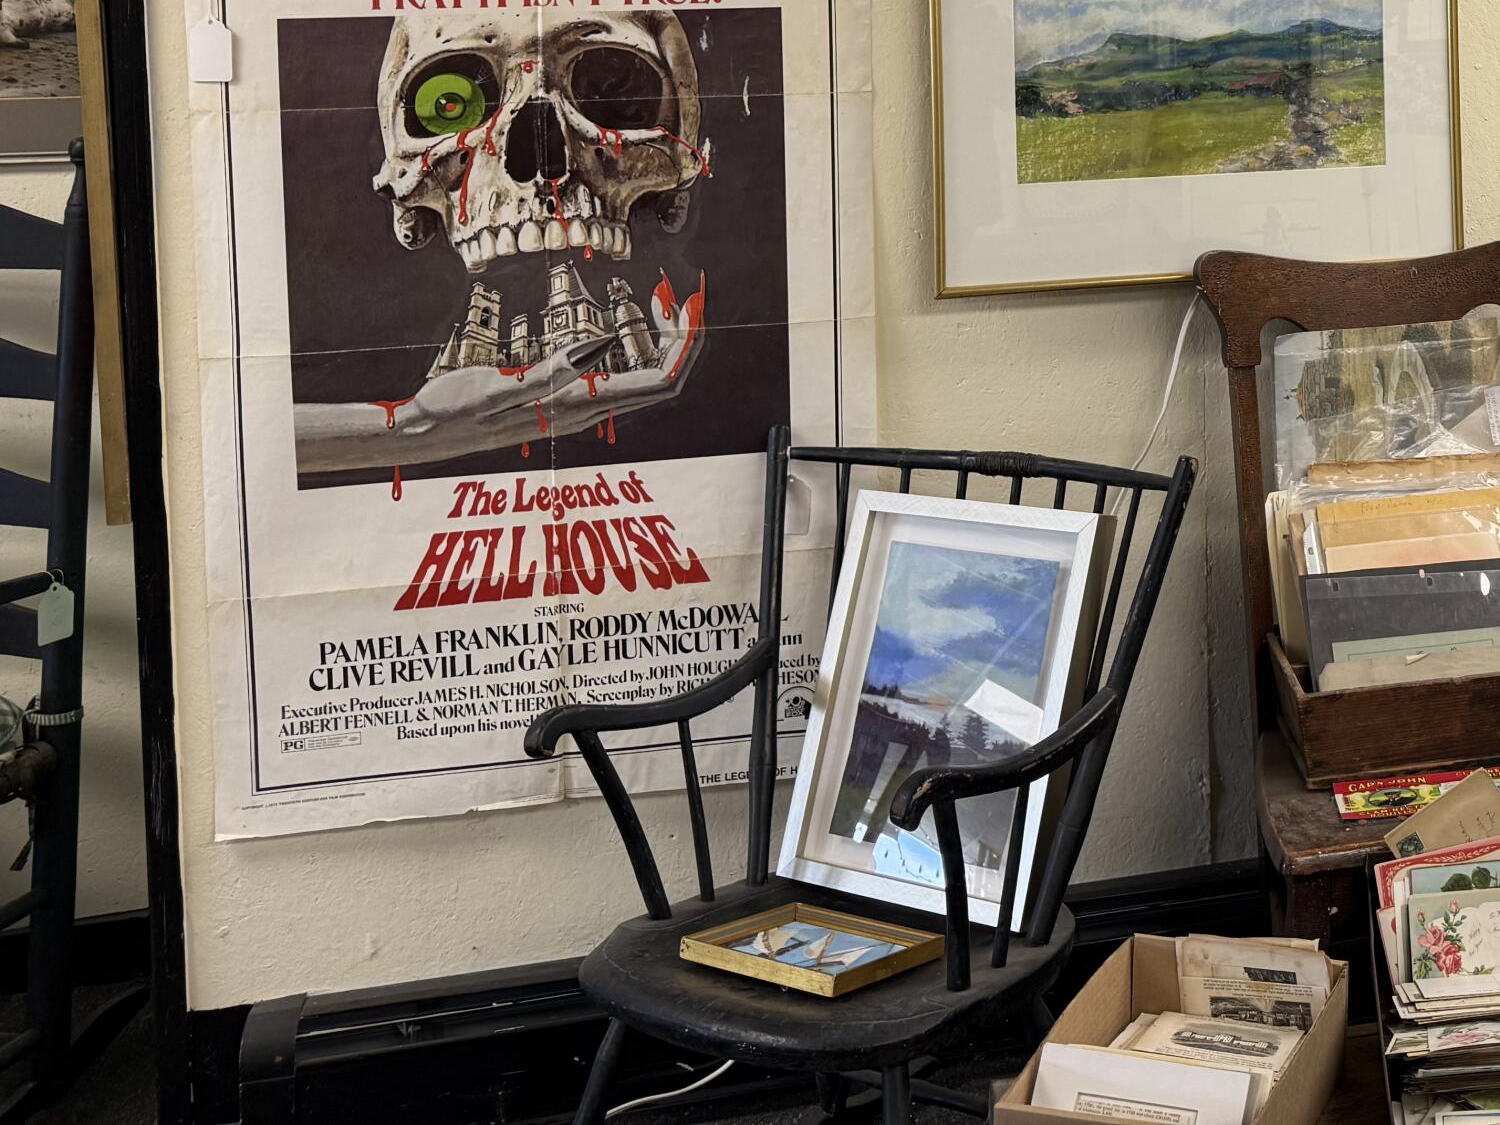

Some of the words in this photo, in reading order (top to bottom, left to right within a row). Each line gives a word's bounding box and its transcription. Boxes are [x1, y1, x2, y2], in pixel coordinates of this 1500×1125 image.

[447, 480, 507, 518] The
[512, 472, 619, 521] Legend
[619, 470, 654, 506] of
[393, 525, 538, 611] HELL
[542, 515, 711, 596] HOUSE
[319, 634, 429, 665] PAMELA
[435, 621, 563, 655] FRANKLIN,
[570, 611, 653, 641] RODDY
[656, 603, 789, 632] McDOWA
[534, 603, 585, 618] STARRING
[309, 662, 384, 691] CLIVE
[391, 653, 481, 684] REVILL
[483, 656, 515, 676] and
[518, 642, 598, 672] GAYLE
[603, 627, 745, 661] HUNNICUTT
[278, 716, 342, 737] ALBERT
[344, 708, 414, 730] FENNELL
[416, 708, 430, 722] &
[432, 700, 500, 721] NORMAN
[501, 700, 513, 714] T.
[587, 684, 656, 702] Screenplay
[660, 683, 674, 696] by
[281, 700, 347, 720] Executive
[350, 694, 414, 713] Producer
[414, 687, 467, 706] JAMES
[469, 685, 484, 699] H.
[485, 677, 569, 698] NICHOLSON,
[572, 669, 629, 688] Directed
[630, 668, 646, 683] by
[646, 664, 685, 681] JOHN
[283, 740, 304, 751] PG
[396, 722, 438, 740] Based
[440, 721, 476, 739] upon
[477, 718, 498, 732] his
[700, 773, 721, 785] THE
[1386, 776, 1427, 787] JOHN
